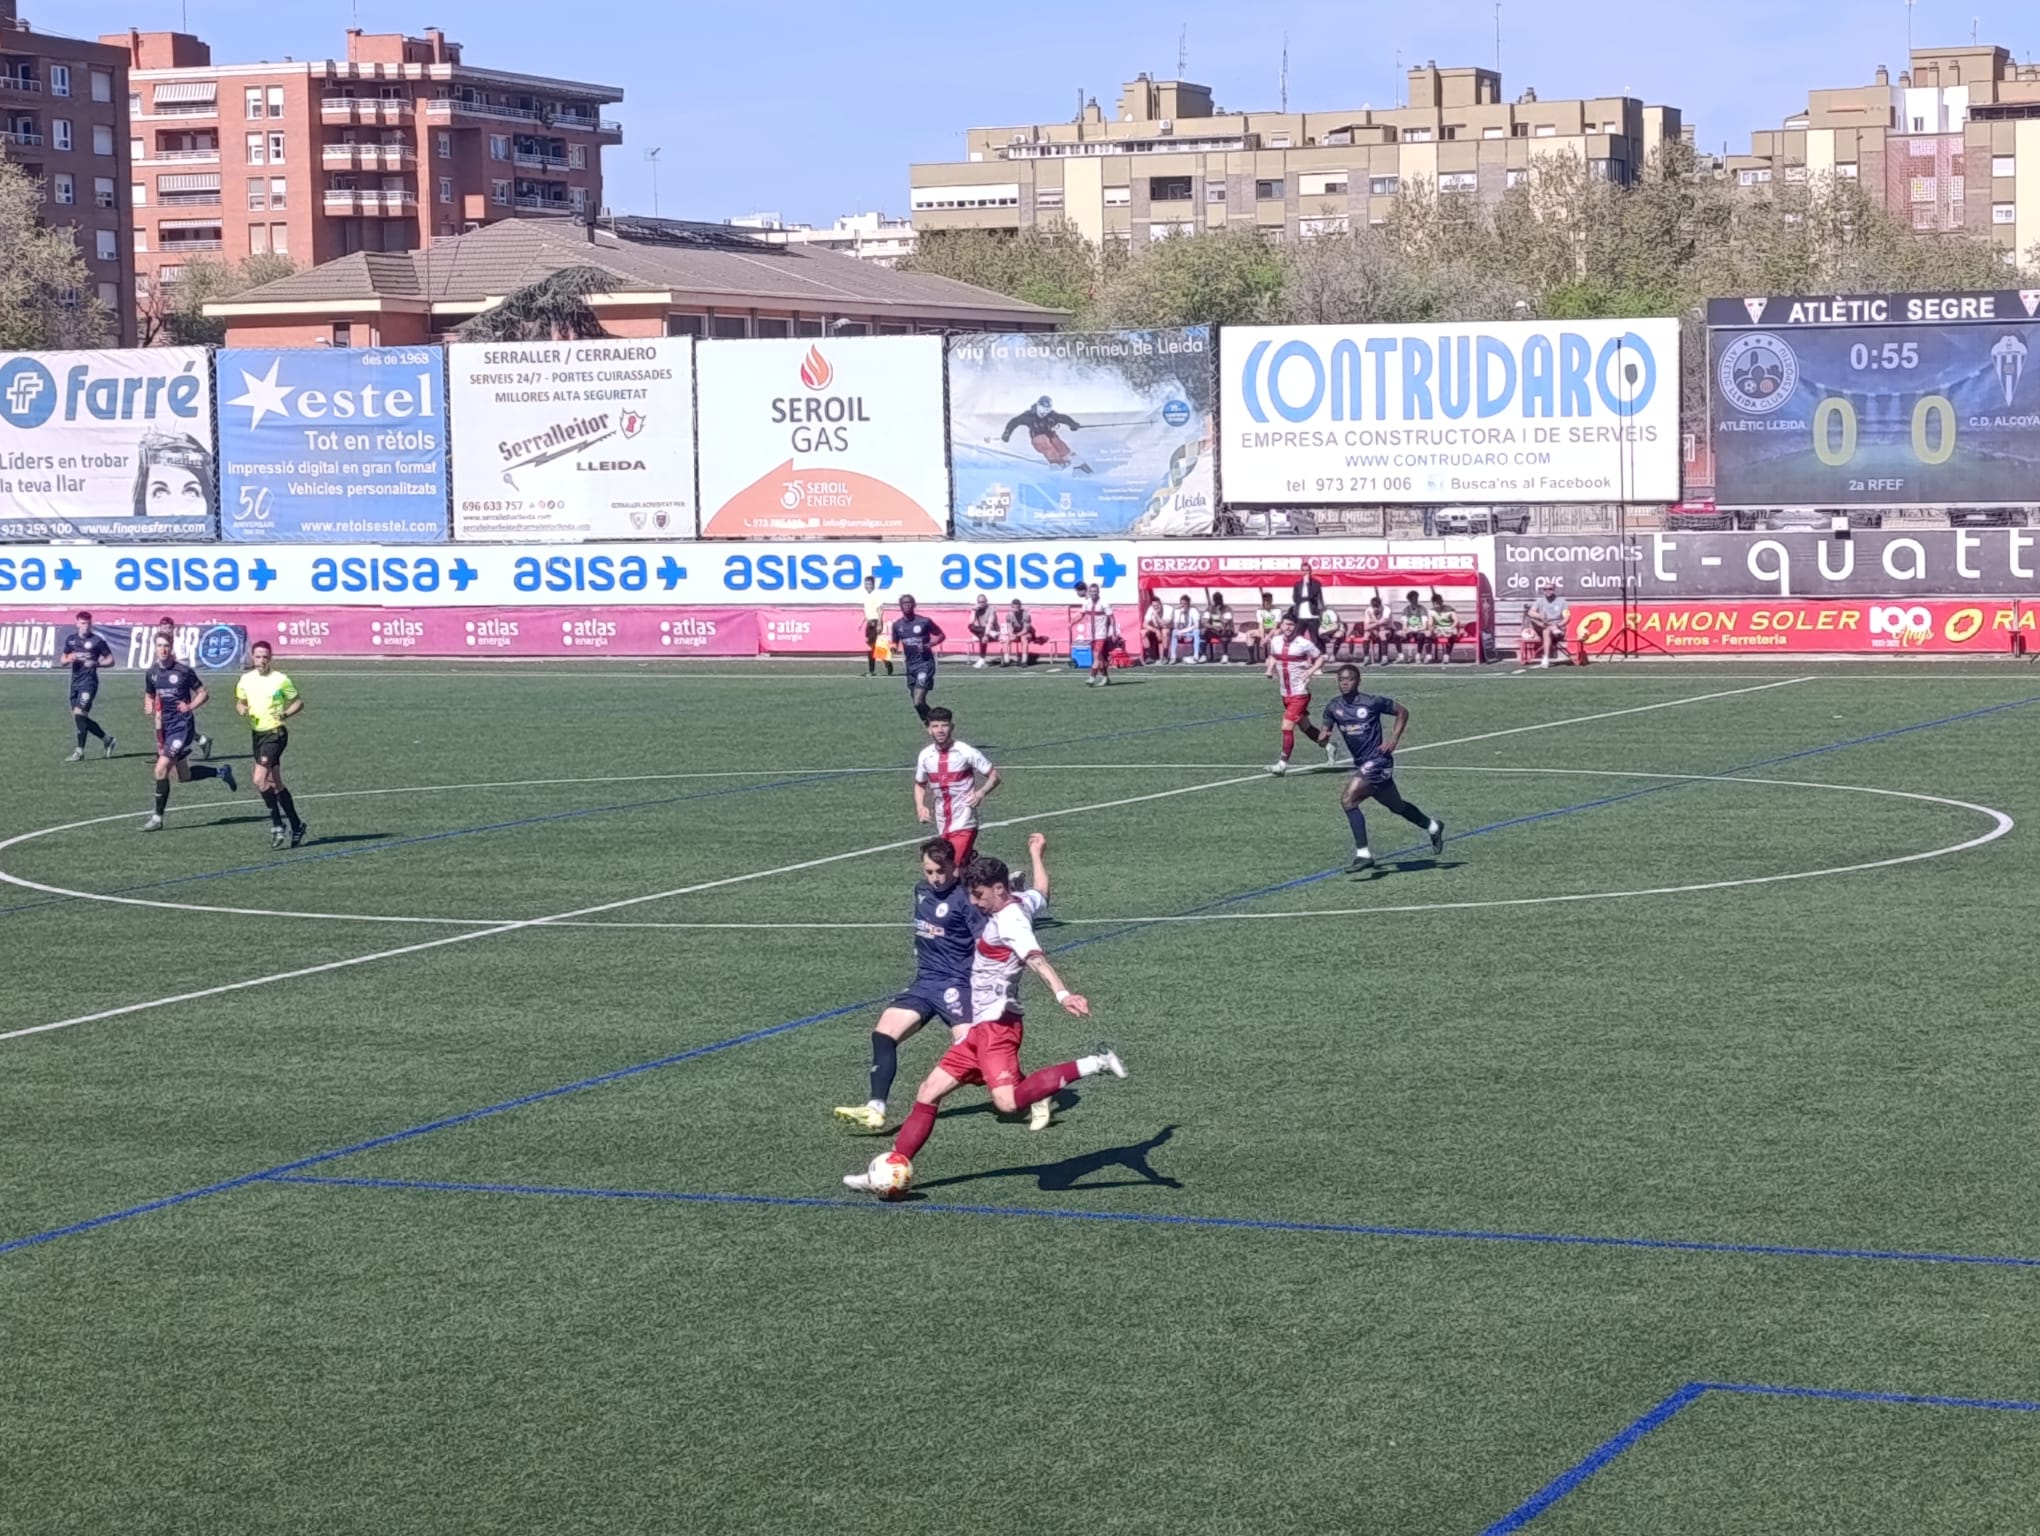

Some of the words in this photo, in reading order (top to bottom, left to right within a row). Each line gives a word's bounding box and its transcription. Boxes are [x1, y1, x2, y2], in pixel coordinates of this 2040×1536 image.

[1788, 296, 1888, 323] ATLÈTIC
[1907, 297, 1995, 320] SEGRE
[484, 350, 560, 364] SERRALLER
[564, 348, 572, 365] /
[576, 347, 656, 362] CERRAJERO
[1016, 344, 1049, 358] neu
[1056, 341, 1072, 357] al
[1076, 341, 1129, 357] Pirineu
[1134, 339, 1152, 355] de
[1159, 337, 1203, 354] Lleida
[1850, 342, 1919, 369] 0:55
[362, 355, 381, 365] des
[384, 354, 397, 365] de
[400, 353, 429, 364] 1968
[470, 373, 513, 385] SERVEIS
[517, 371, 542, 385] 24/7
[552, 371, 594, 383] PORTES
[597, 369, 672, 381] CUIRASSADES
[1242, 332, 1656, 423] CONTRUDARO
[65, 361, 200, 421] farré
[297, 372, 435, 418] estel
[495, 391, 550, 403] MILLORES
[553, 390, 580, 402] ALTA
[583, 389, 648, 401] SEGURETAT
[771, 397, 870, 423] SEROIL
[1766, 419, 1806, 430] LLEIDA
[1813, 396, 1857, 466] 0
[1911, 395, 1956, 465] 0
[304, 431, 338, 450] Tot
[344, 435, 369, 450] en
[377, 430, 435, 450] rètols
[498, 413, 610, 461] Serralleitor
[792, 426, 849, 452] GAS
[1242, 432, 1338, 448] EMPRESA
[1345, 428, 1516, 446] CONSTRUCTORA
[1535, 428, 1560, 443] DE
[1569, 426, 1657, 442] SERVEIS
[0, 452, 54, 469] Líders
[58, 456, 77, 469] en
[81, 453, 129, 468] trobar
[228, 461, 294, 476] Impressió
[298, 461, 338, 477] digital
[343, 463, 358, 474] en
[362, 463, 391, 476] gran
[395, 461, 436, 474] format
[576, 461, 646, 471] LLEIDA
[0, 477, 12, 493] la
[18, 479, 52, 493] teva
[56, 474, 86, 492] llar
[288, 483, 343, 495] Vehicles
[347, 482, 436, 497] personalitzats
[807, 482, 848, 493] SEROIL
[1316, 478, 1344, 491] 973
[1350, 478, 1376, 490] 271
[1383, 477, 1412, 490] 006
[1451, 478, 1517, 490] Busca'ns
[1523, 477, 1535, 489] al
[1540, 477, 1611, 489] Facebook
[1849, 479, 1864, 491] 2a
[1868, 479, 1904, 490] RFEF
[462, 501, 481, 511] 696
[505, 501, 523, 511] 757
[807, 494, 852, 506] ENERGY
[50, 522, 73, 534] 100
[301, 520, 437, 532] www.retolsestel.com
[1506, 543, 1643, 563] tancaments
[724, 554, 862, 590] asisa
[940, 552, 1084, 590] asisa
[1141, 558, 1210, 571] CEREZO
[1308, 556, 1379, 569] CEREZO
[115, 558, 240, 591] asisa
[311, 557, 440, 592] asisa
[513, 556, 648, 591] asisa
[1507, 572, 1529, 588] de
[289, 618, 330, 636] atlas
[383, 617, 424, 636] atlas
[477, 618, 519, 636] atlas
[575, 618, 616, 636] atlas
[672, 617, 716, 636] atlas
[777, 619, 811, 634] atlas
[1749, 610, 1860, 631] SOLER
[1869, 606, 1932, 633] 100
[1666, 634, 1709, 646] Ferros
[1722, 633, 1787, 646] Ferreteria
